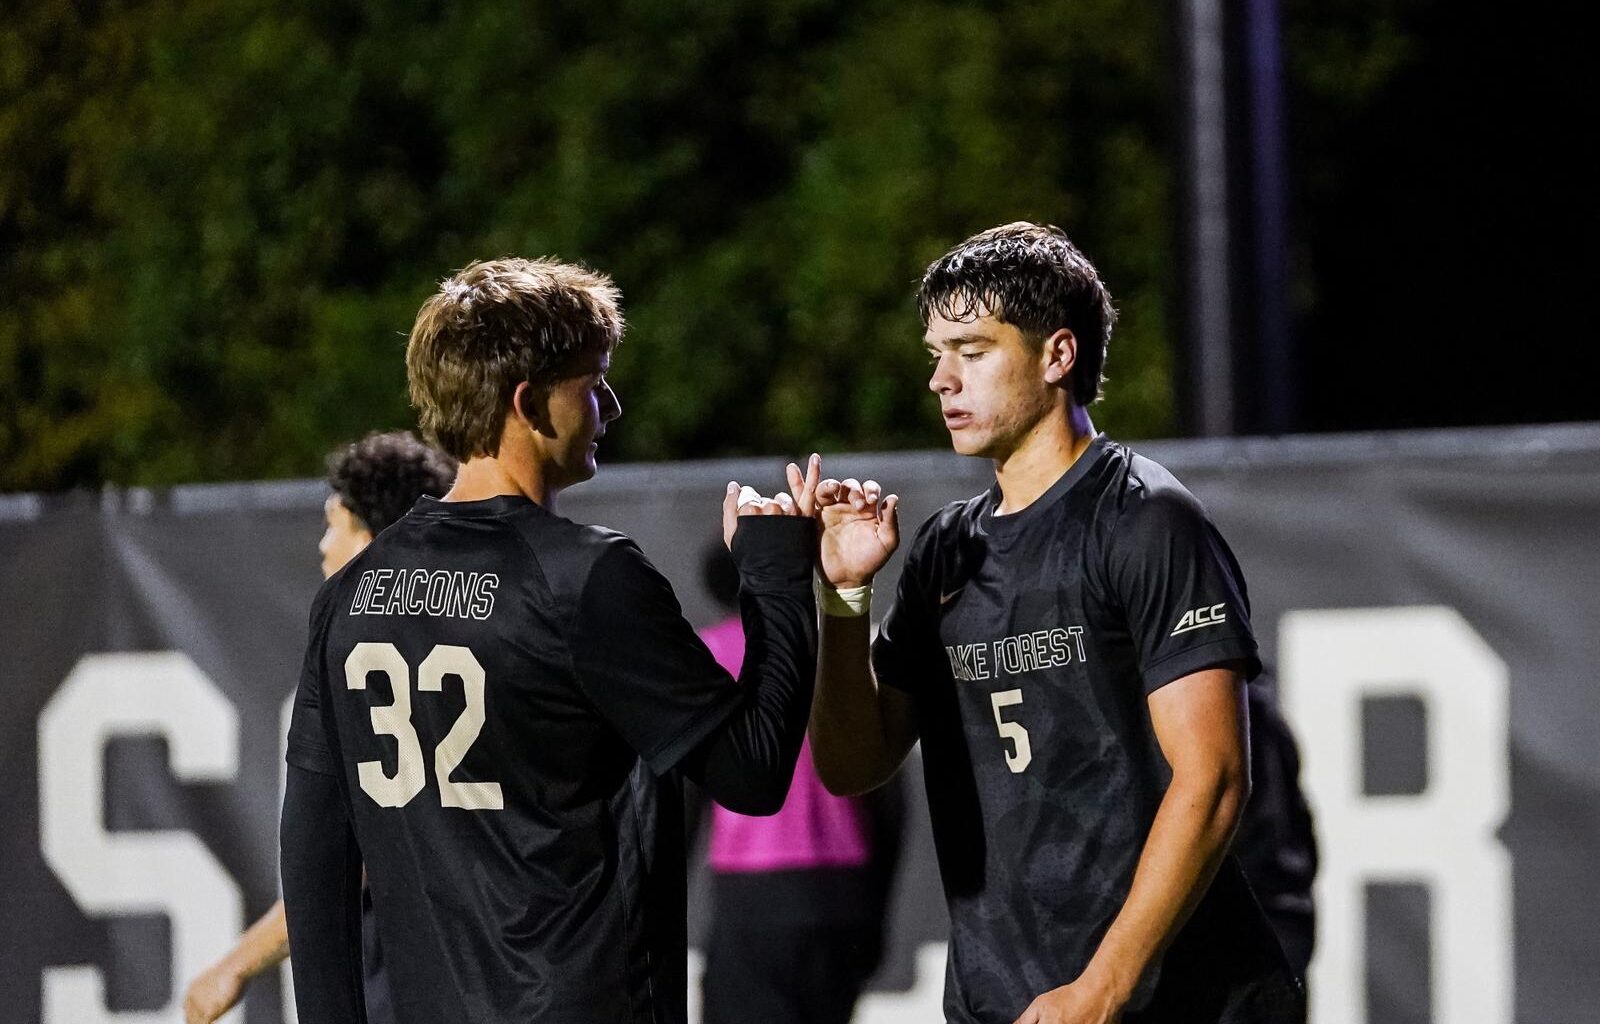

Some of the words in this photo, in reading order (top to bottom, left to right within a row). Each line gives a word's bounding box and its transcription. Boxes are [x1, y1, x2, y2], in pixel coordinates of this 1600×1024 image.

[349, 568, 500, 621] DEACONS
[1173, 602, 1226, 631] ACC
[344, 641, 505, 811] 32
[990, 688, 1032, 774] 5
